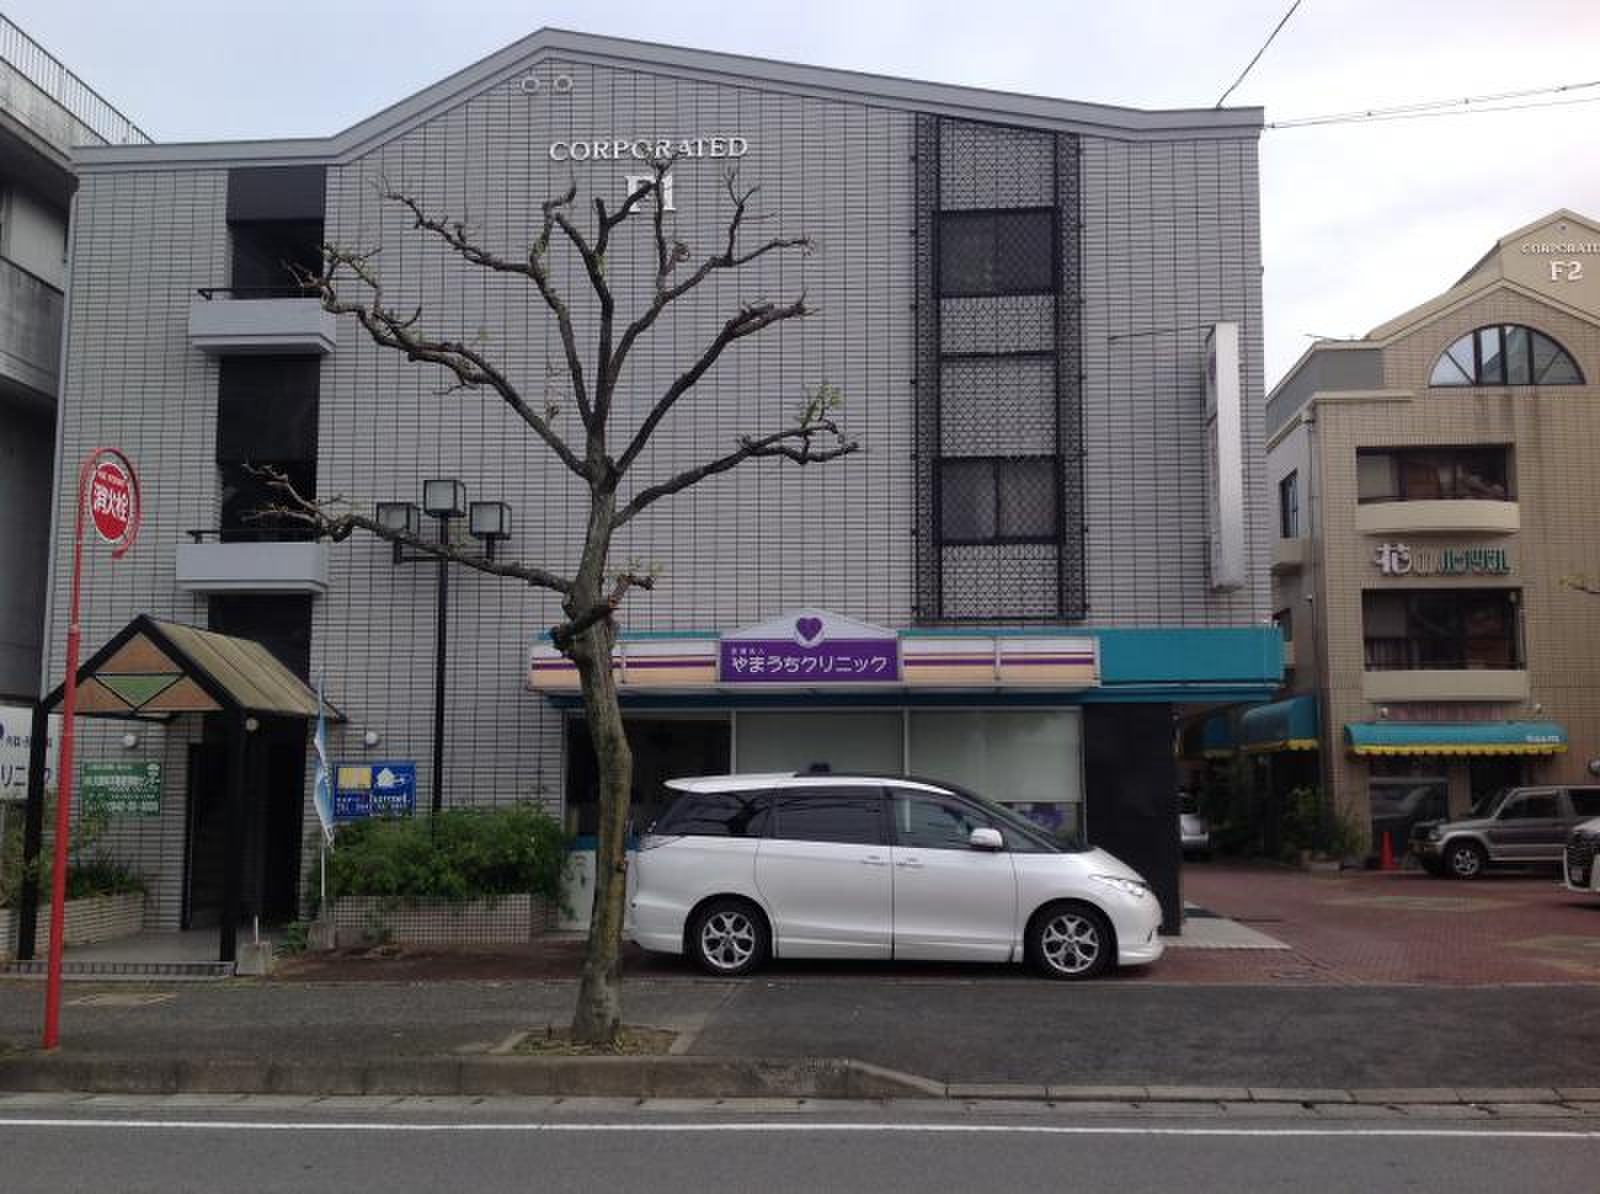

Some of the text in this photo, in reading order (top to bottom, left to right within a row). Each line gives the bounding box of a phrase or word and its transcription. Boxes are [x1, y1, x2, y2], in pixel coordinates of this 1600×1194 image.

[549, 137, 749, 161] CORPORATED
[1550, 260, 1584, 281] F2
[731, 655, 888, 673] やまうちクリニック
